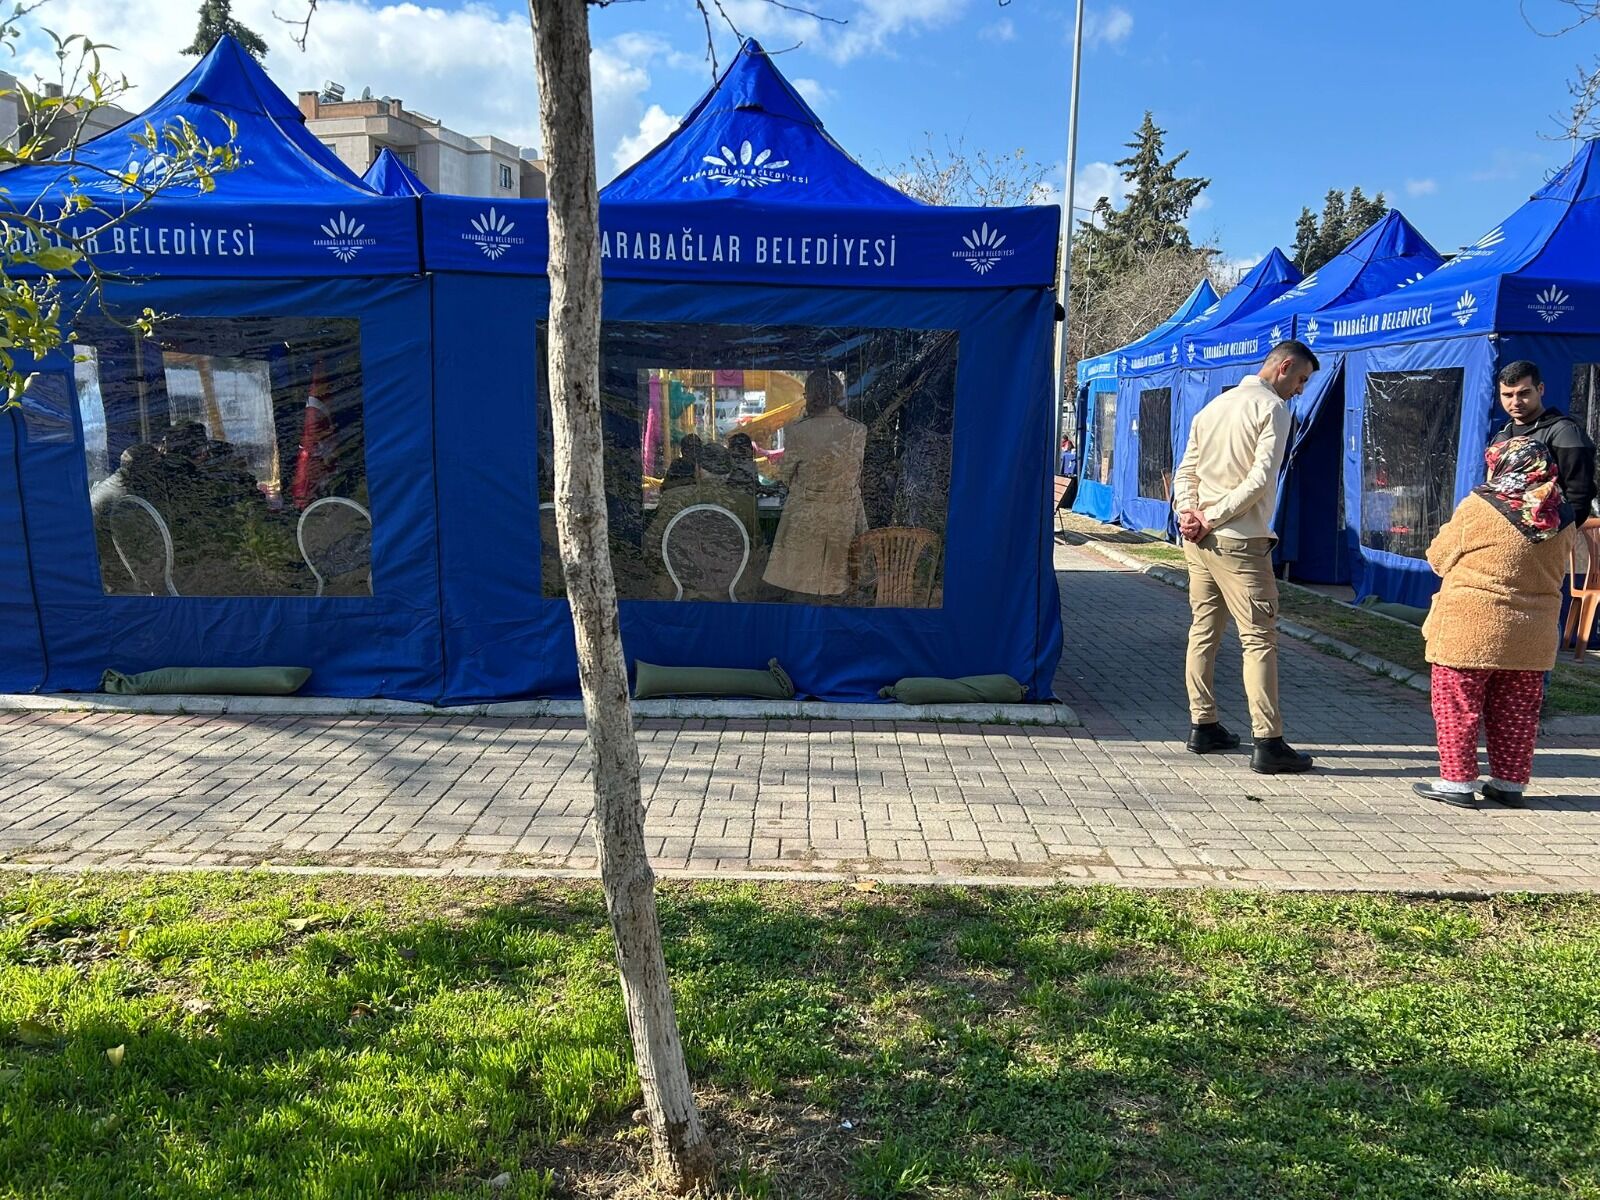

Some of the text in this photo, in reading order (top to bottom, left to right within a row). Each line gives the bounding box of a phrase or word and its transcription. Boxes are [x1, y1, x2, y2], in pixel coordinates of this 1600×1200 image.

[113, 222, 255, 256] BELEDİYESİ
[600, 226, 896, 267] ARABAĞLAR BELEDİYESİ
[1333, 303, 1433, 337] KARABAĞLAR BELEDİYESİ
